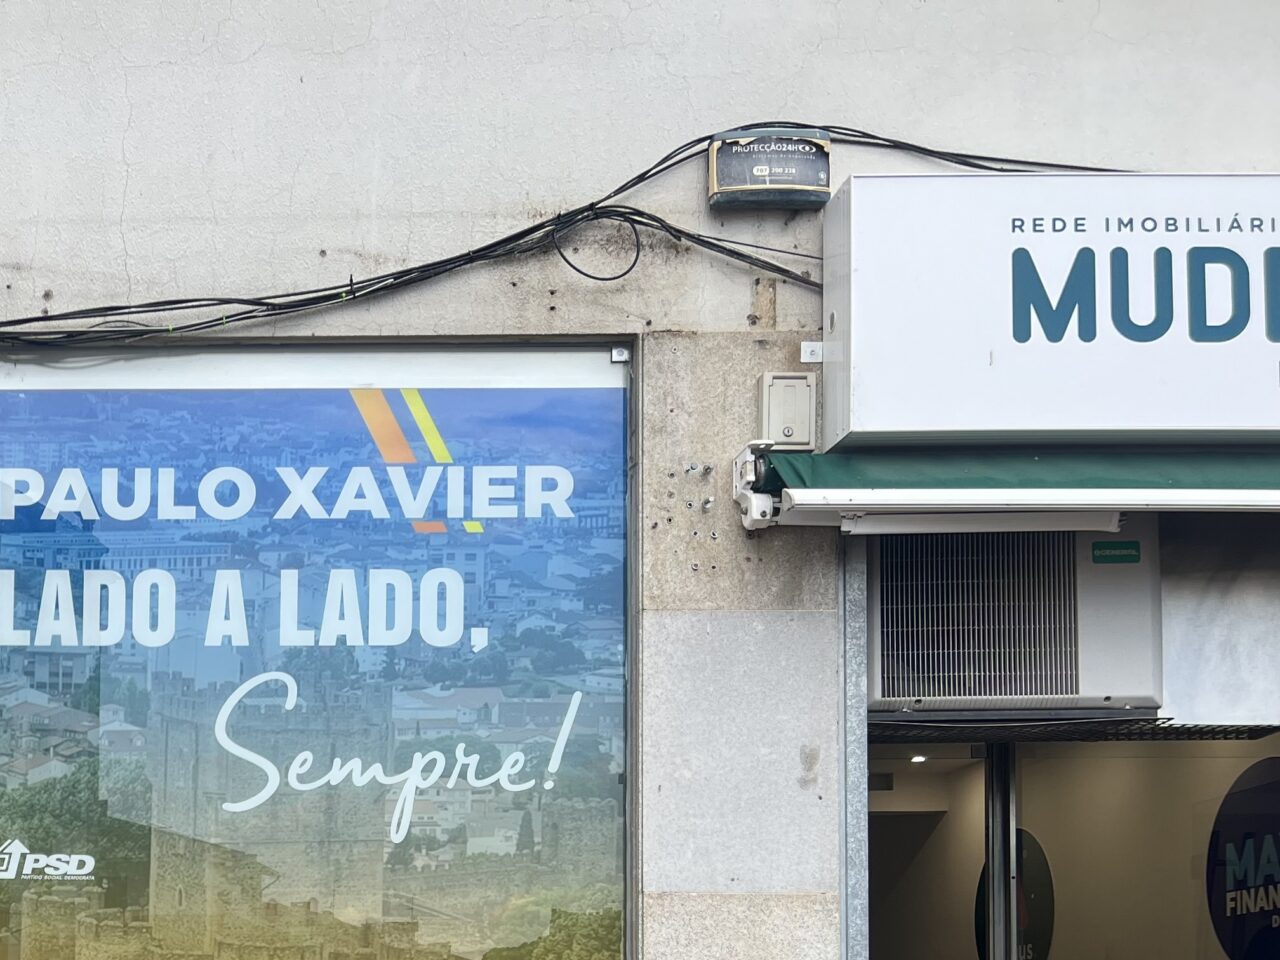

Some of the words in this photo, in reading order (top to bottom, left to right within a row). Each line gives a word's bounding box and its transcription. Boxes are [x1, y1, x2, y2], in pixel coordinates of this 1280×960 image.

[1011, 217, 1088, 233] REDE
[1105, 213, 1276, 233] IMOBILIÁRI
[1011, 246, 1280, 344] MUD
[272, 464, 575, 519] XAVIER
[205, 568, 249, 648] A
[279, 567, 489, 653] LADO,
[214, 671, 583, 844] Sempre!
[22, 853, 96, 875] PSD
[1225, 834, 1280, 891] MA
